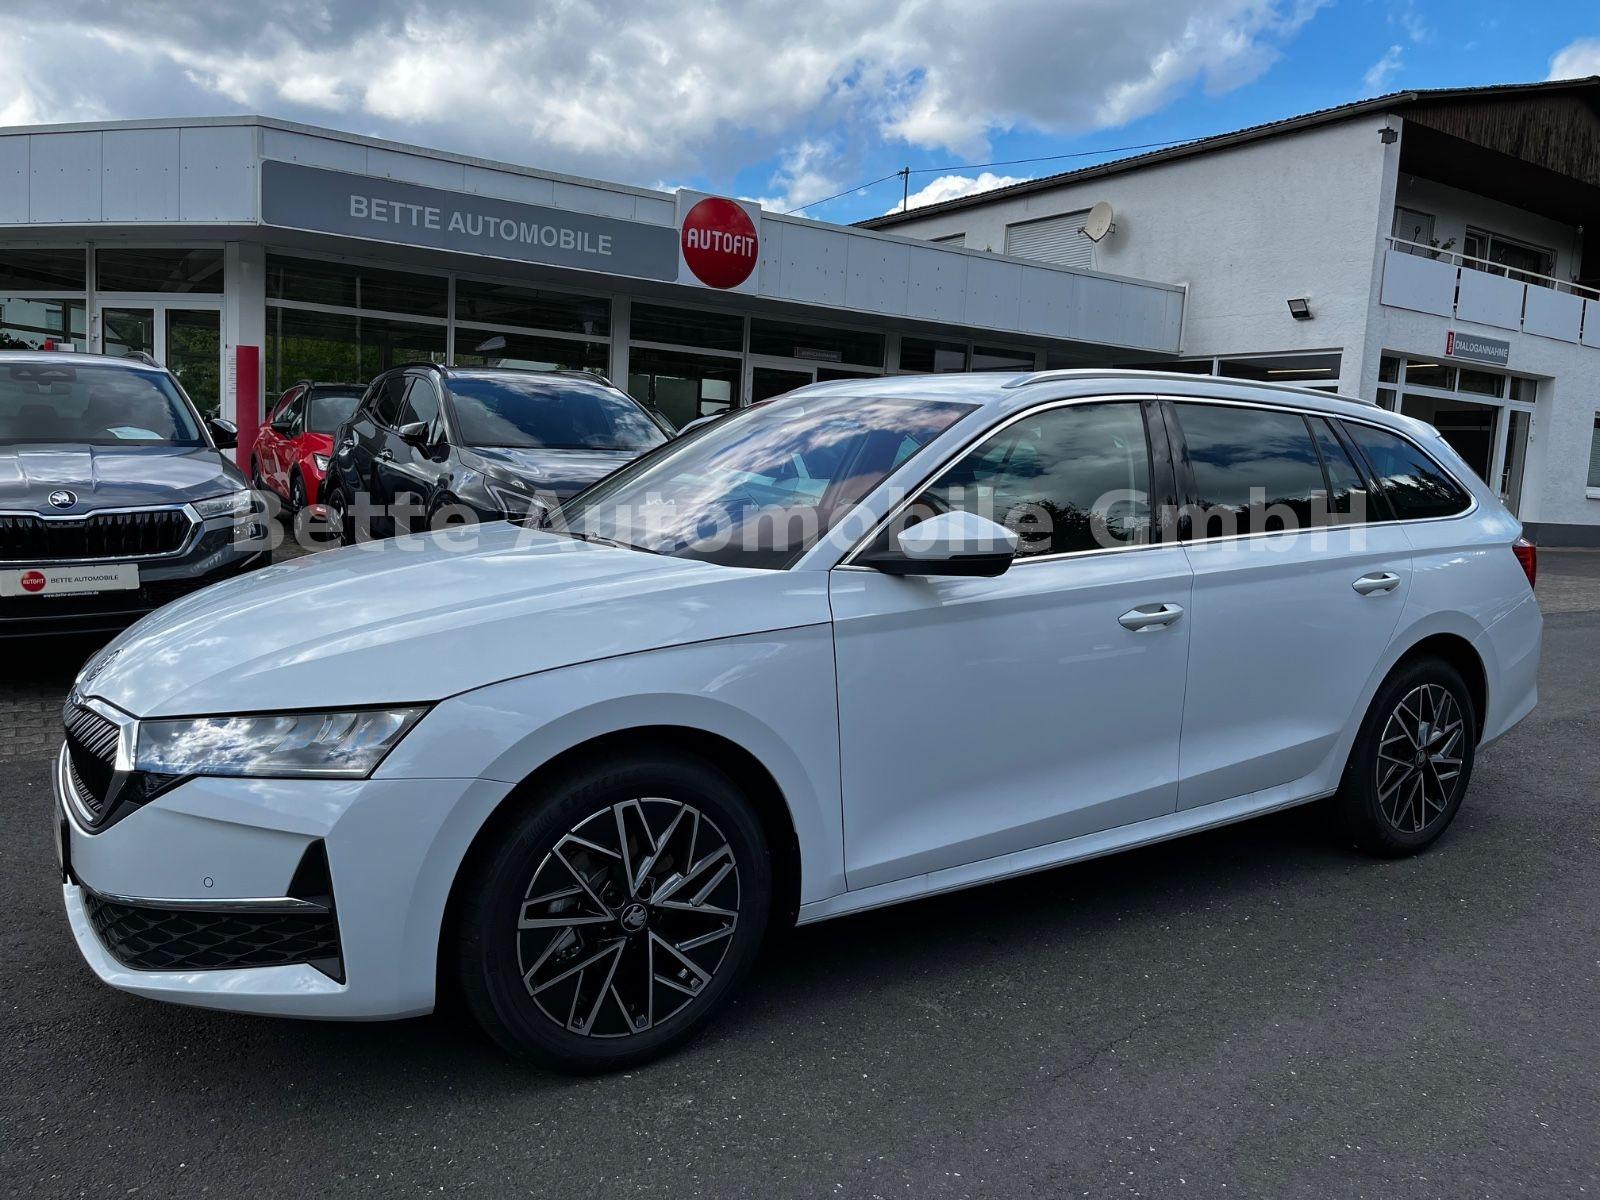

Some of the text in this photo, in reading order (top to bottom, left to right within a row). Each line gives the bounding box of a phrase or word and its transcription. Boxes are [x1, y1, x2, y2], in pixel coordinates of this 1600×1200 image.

[350, 195, 612, 256] BETTE AUTOMOBILE
[687, 227, 755, 258] AUTOFIT
[1455, 340, 1509, 358] DIALOGANNAHME
[74, 574, 119, 583] AUTOMOBILE
